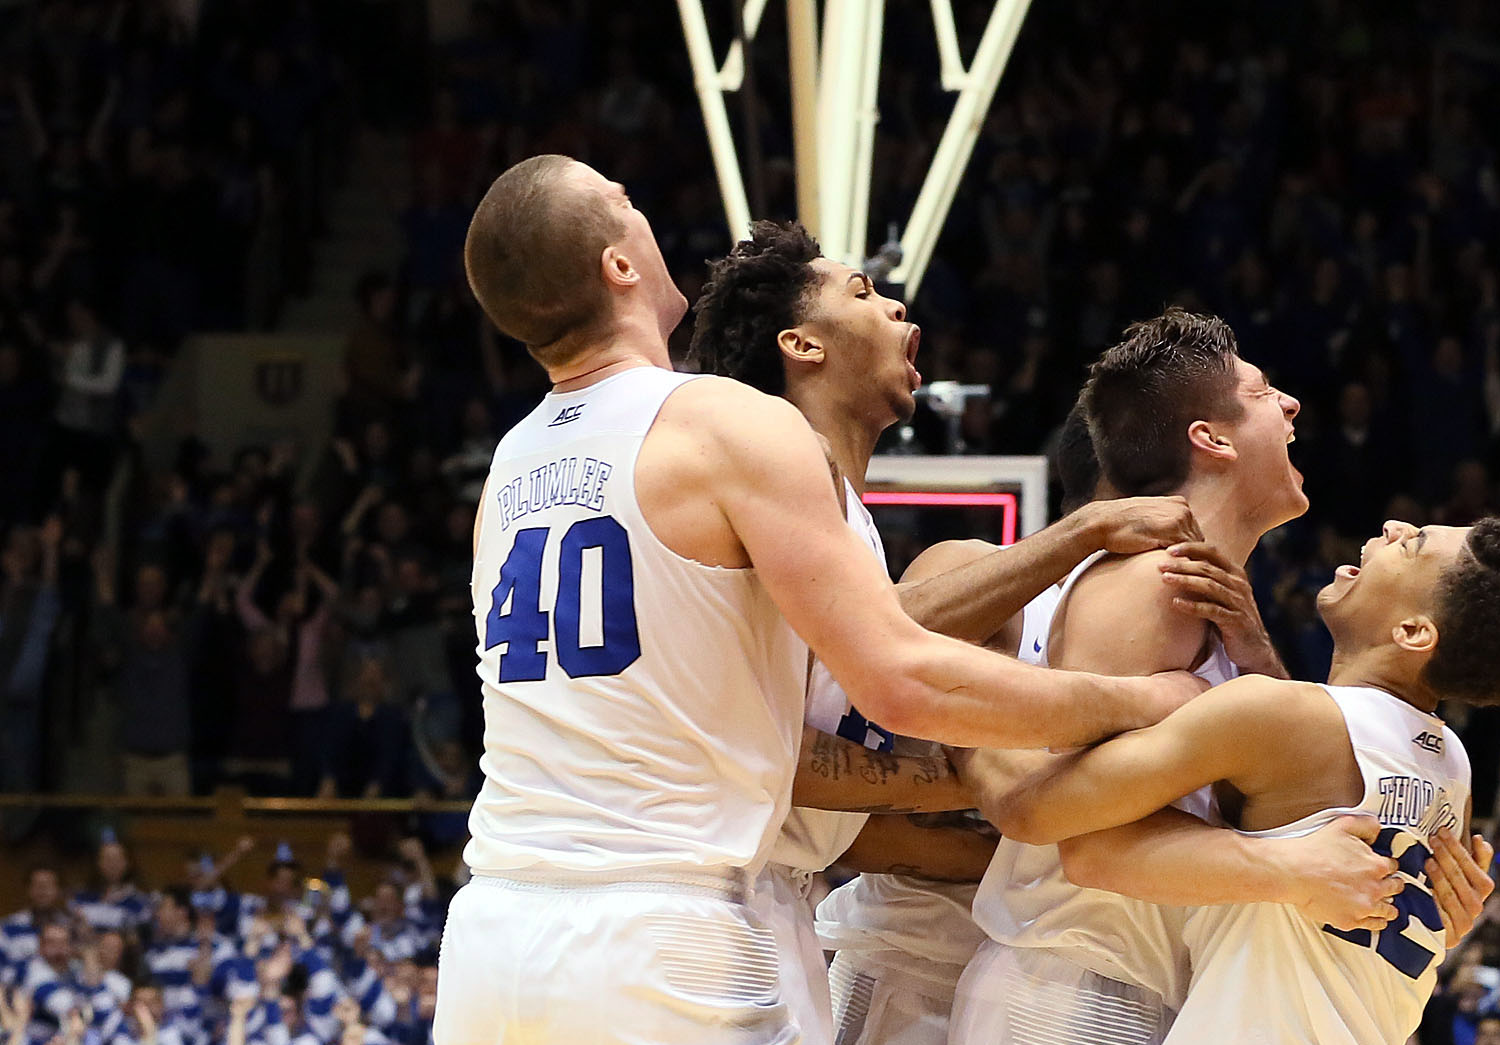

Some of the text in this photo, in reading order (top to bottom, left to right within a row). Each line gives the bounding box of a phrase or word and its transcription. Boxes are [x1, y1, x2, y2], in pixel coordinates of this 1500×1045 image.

[548, 403, 587, 427] ACC
[497, 456, 613, 531] PLUMLEE
[485, 515, 642, 683] 40
[1412, 731, 1444, 753] ACC
